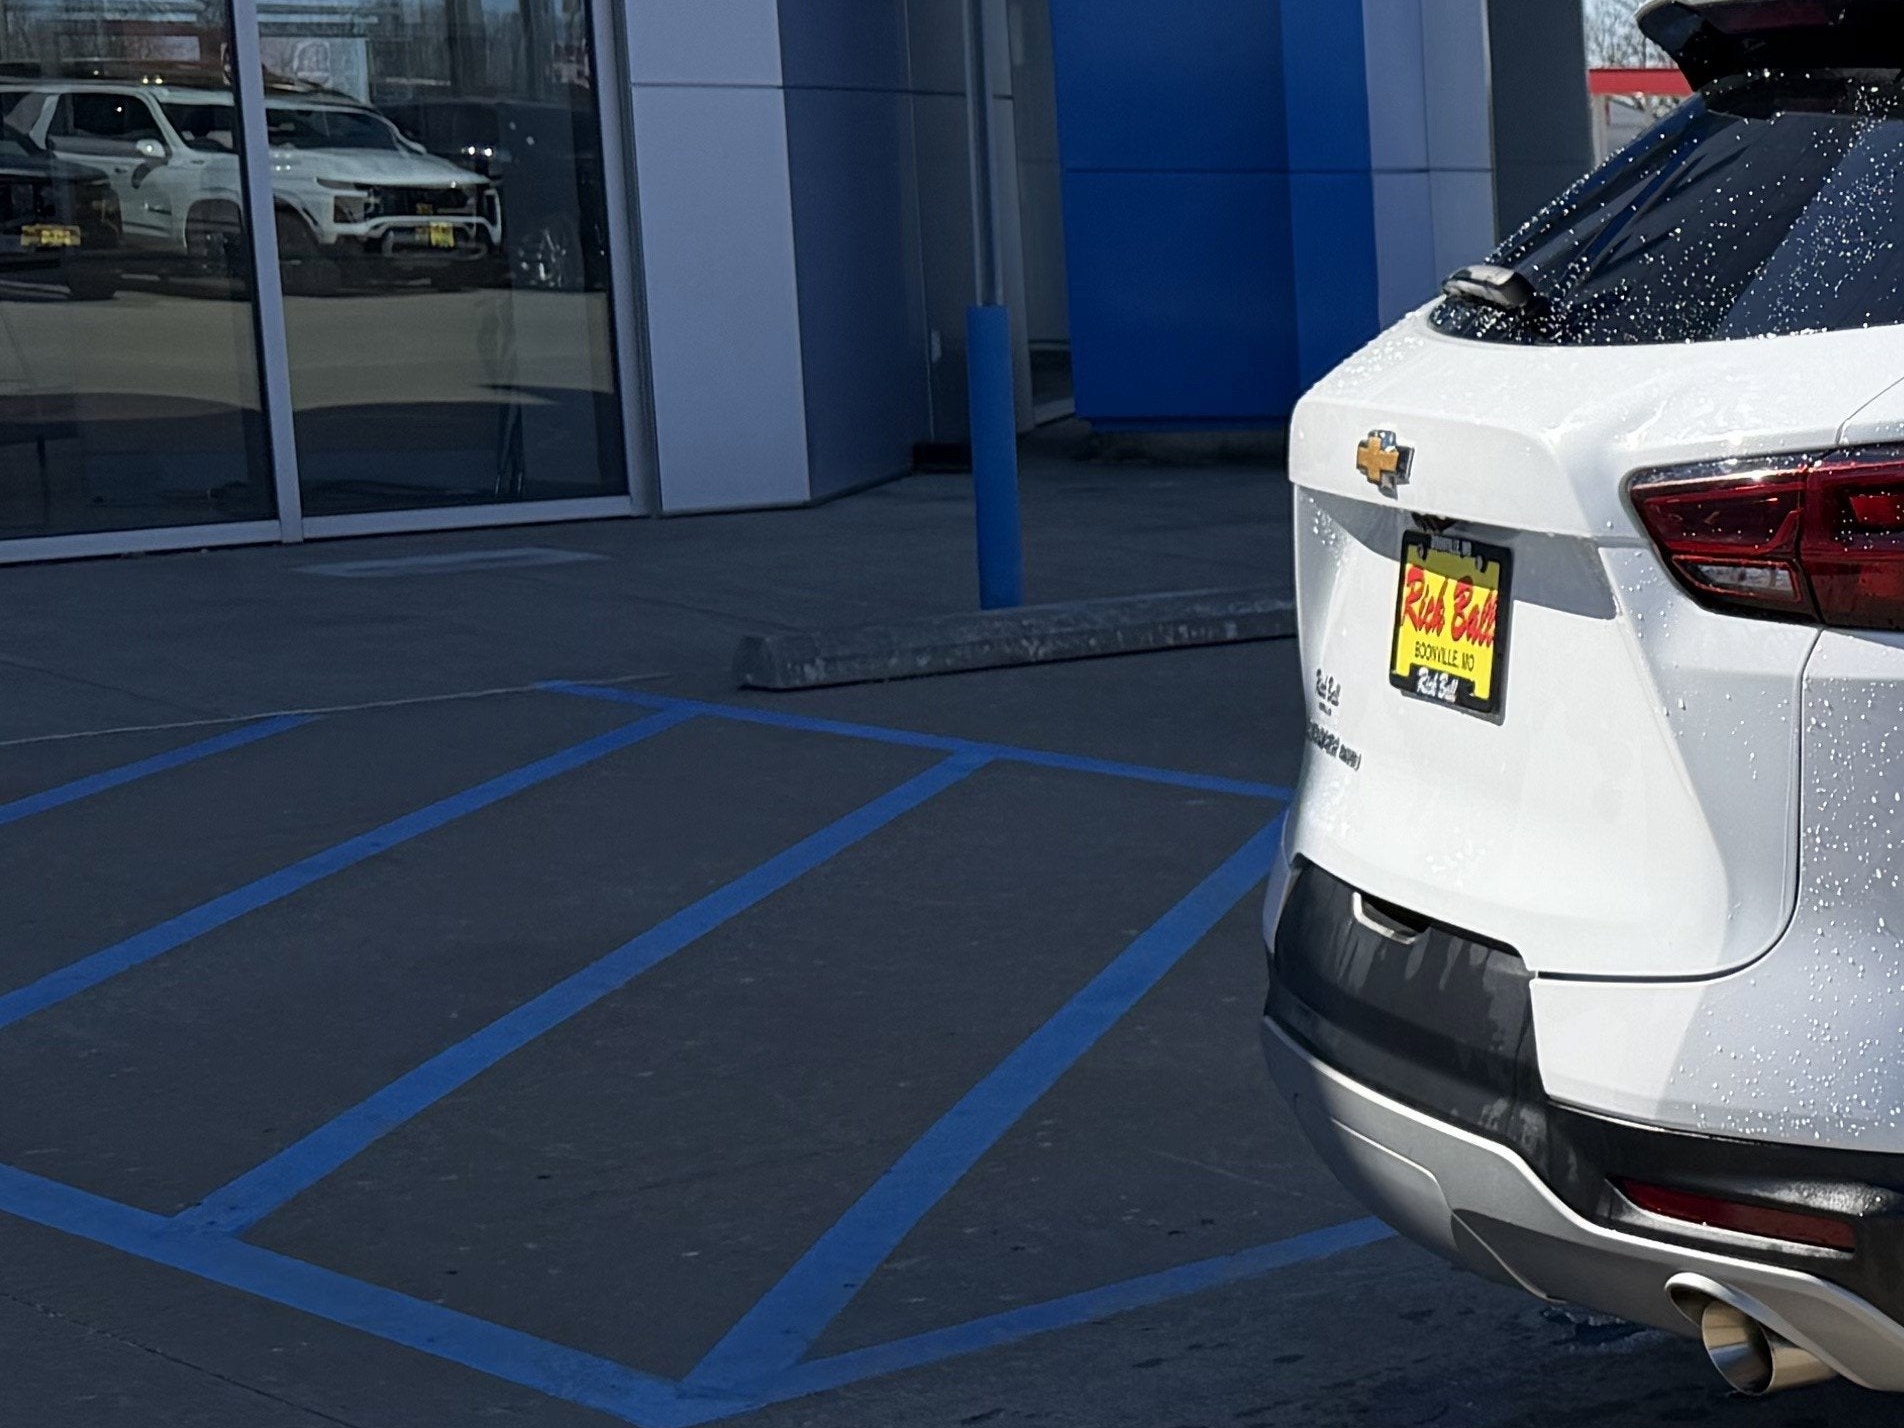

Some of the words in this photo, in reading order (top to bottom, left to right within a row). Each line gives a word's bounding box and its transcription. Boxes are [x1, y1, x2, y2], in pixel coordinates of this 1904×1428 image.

[1402, 563, 1449, 638] Rick
[1451, 575, 1498, 648] Ball
[1461, 652, 1475, 672] MO
